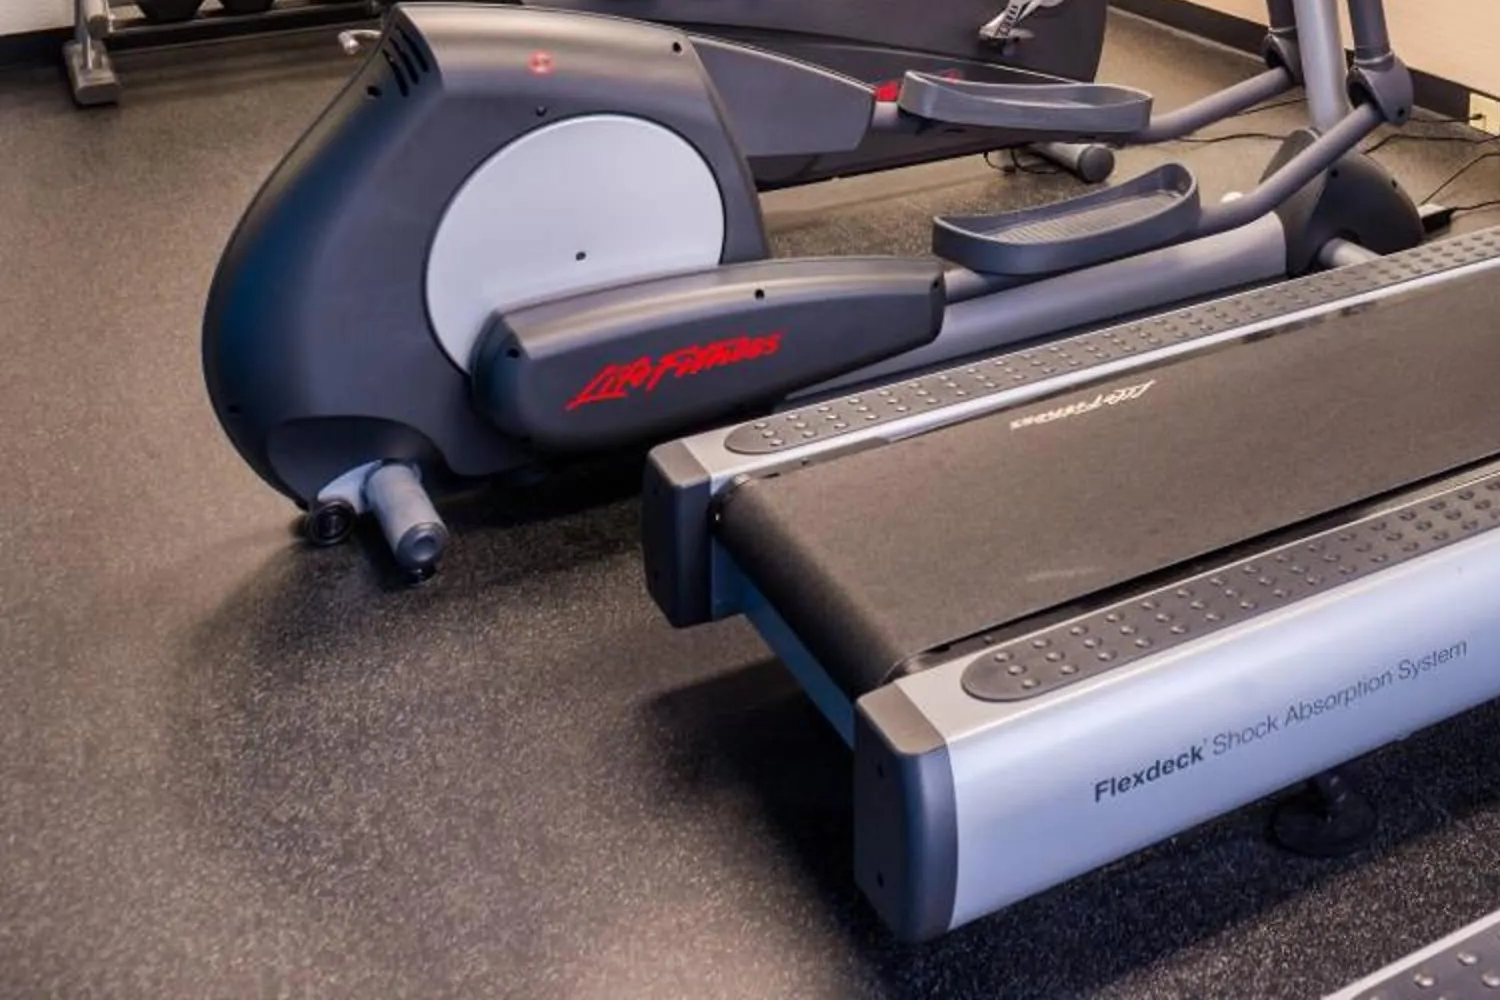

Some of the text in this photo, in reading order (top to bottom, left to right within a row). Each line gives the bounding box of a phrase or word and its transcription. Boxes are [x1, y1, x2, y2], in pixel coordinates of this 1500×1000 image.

[1093, 640, 1468, 803] Flexdeck Shock Absorption System
